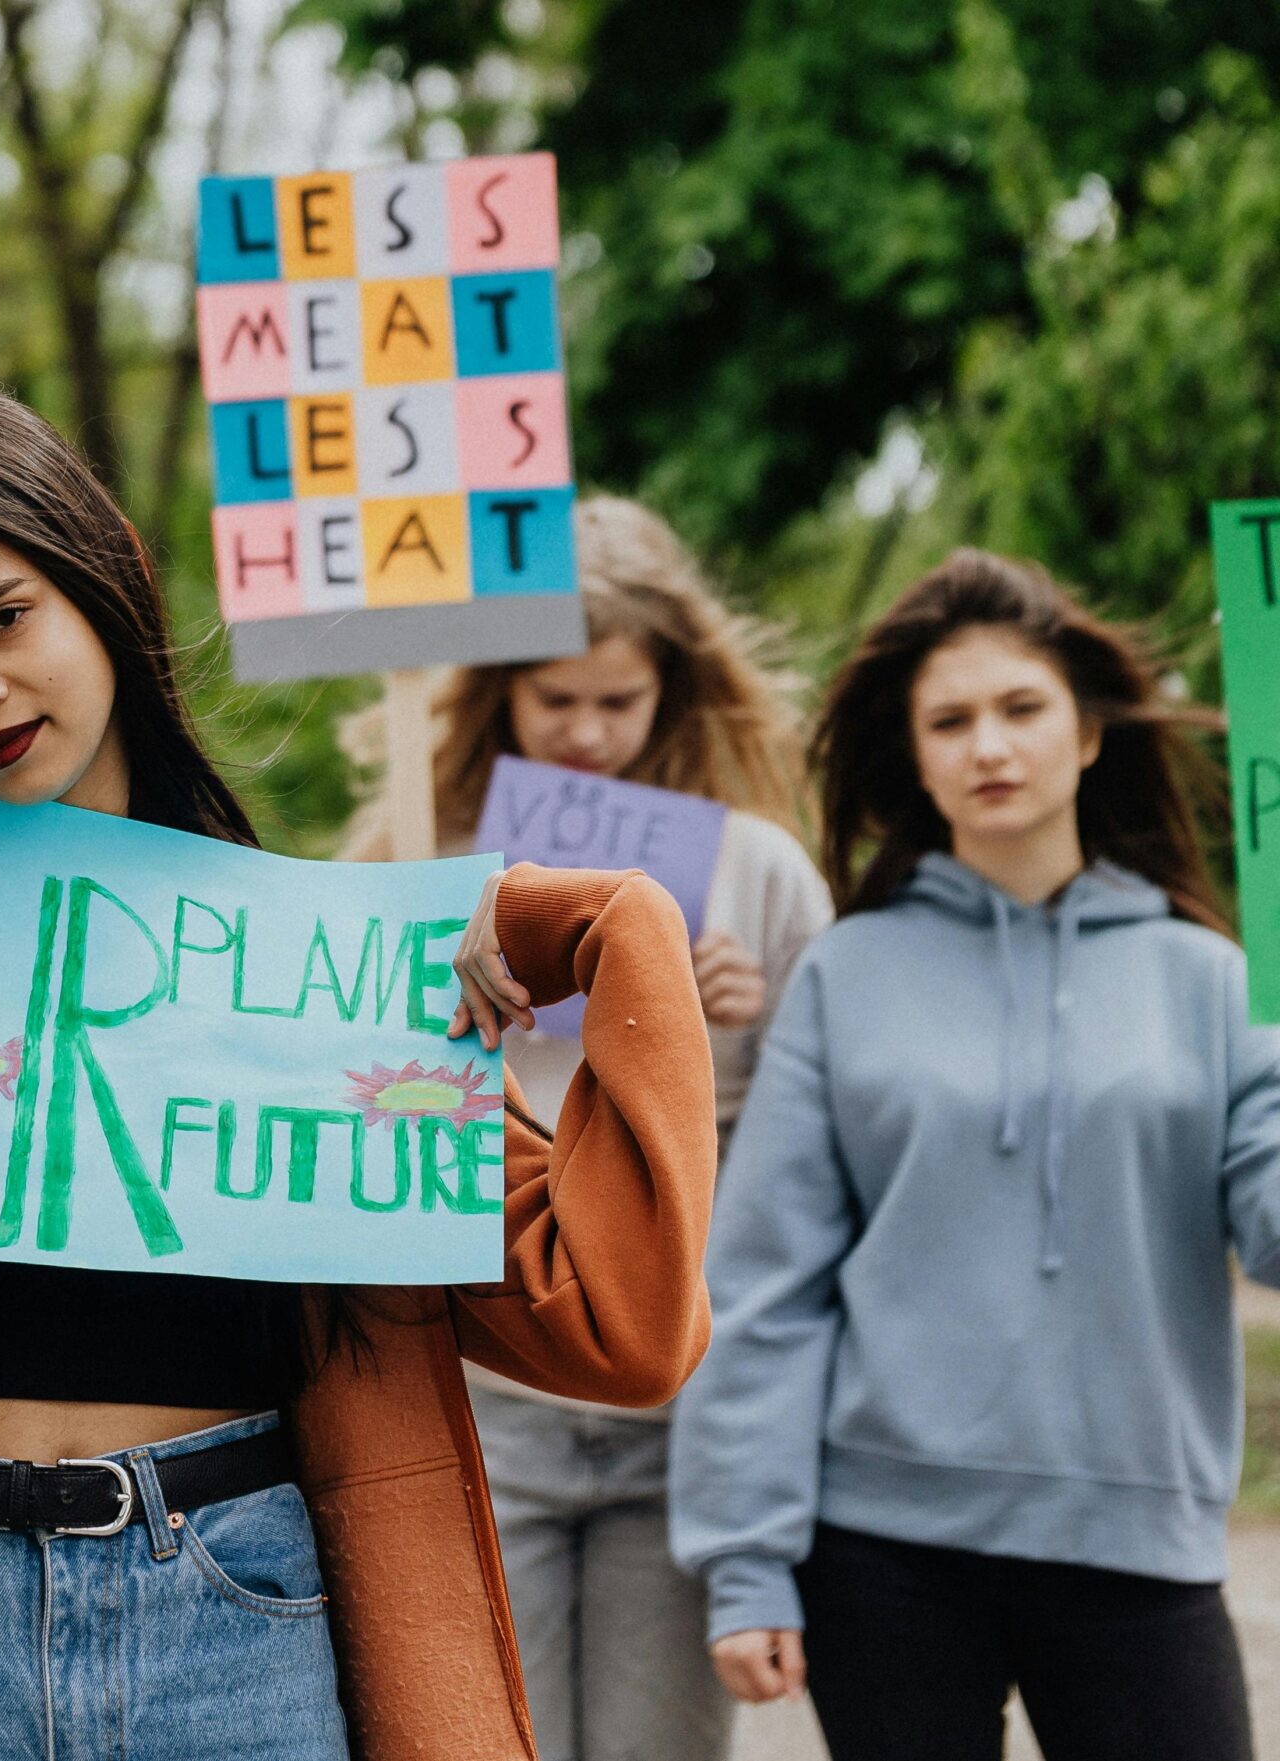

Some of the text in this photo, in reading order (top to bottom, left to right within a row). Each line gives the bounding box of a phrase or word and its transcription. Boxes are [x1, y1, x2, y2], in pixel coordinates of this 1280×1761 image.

[228, 172, 510, 256] LESS
[222, 288, 519, 372] MEAT
[246, 399, 538, 479] LESS
[234, 502, 540, 589] HEAT
[169, 894, 470, 1036] PLANE
[159, 1096, 504, 1216] FUTURE
